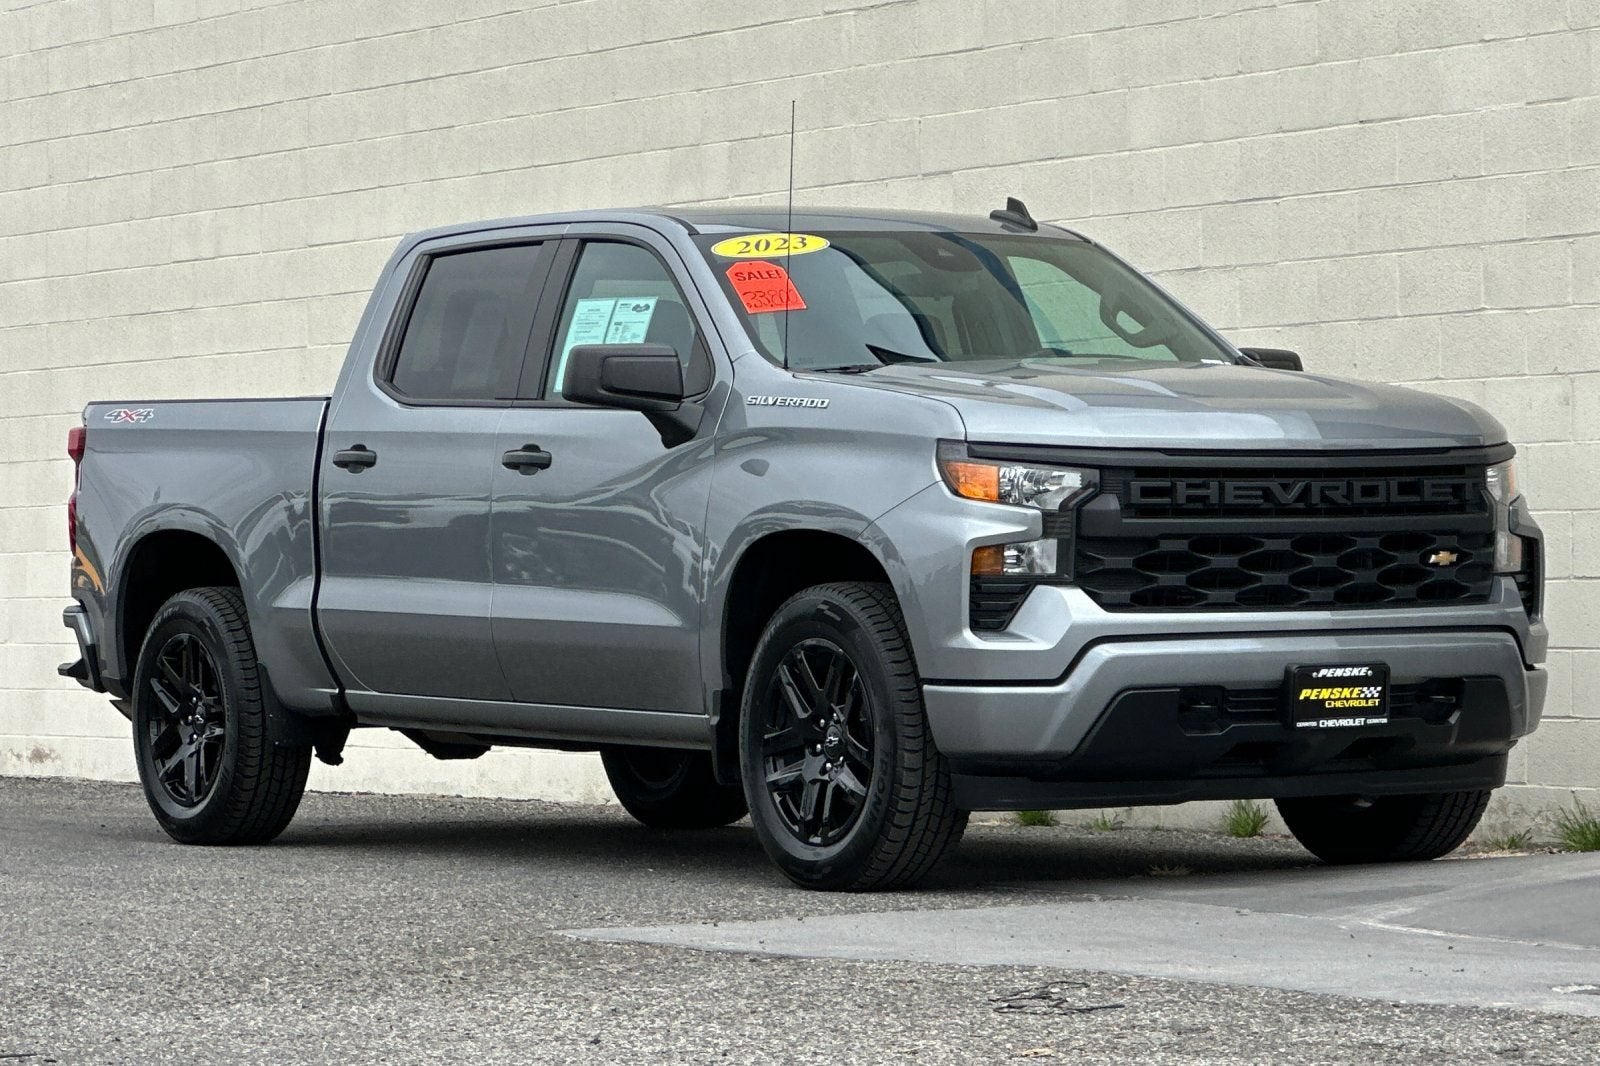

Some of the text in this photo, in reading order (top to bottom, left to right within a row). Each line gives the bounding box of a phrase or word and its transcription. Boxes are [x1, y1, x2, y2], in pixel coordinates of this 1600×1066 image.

[737, 237, 807, 254] 2023
[735, 270, 782, 281] SALE!
[747, 395, 829, 408] SILVERADO
[1129, 478, 1477, 506] CHEVROLET
[1318, 667, 1369, 677] PENSKE
[1299, 687, 1363, 699] PENSKE
[1325, 699, 1380, 708] CHEVROLET
[1319, 718, 1366, 727] CHEVROLET
